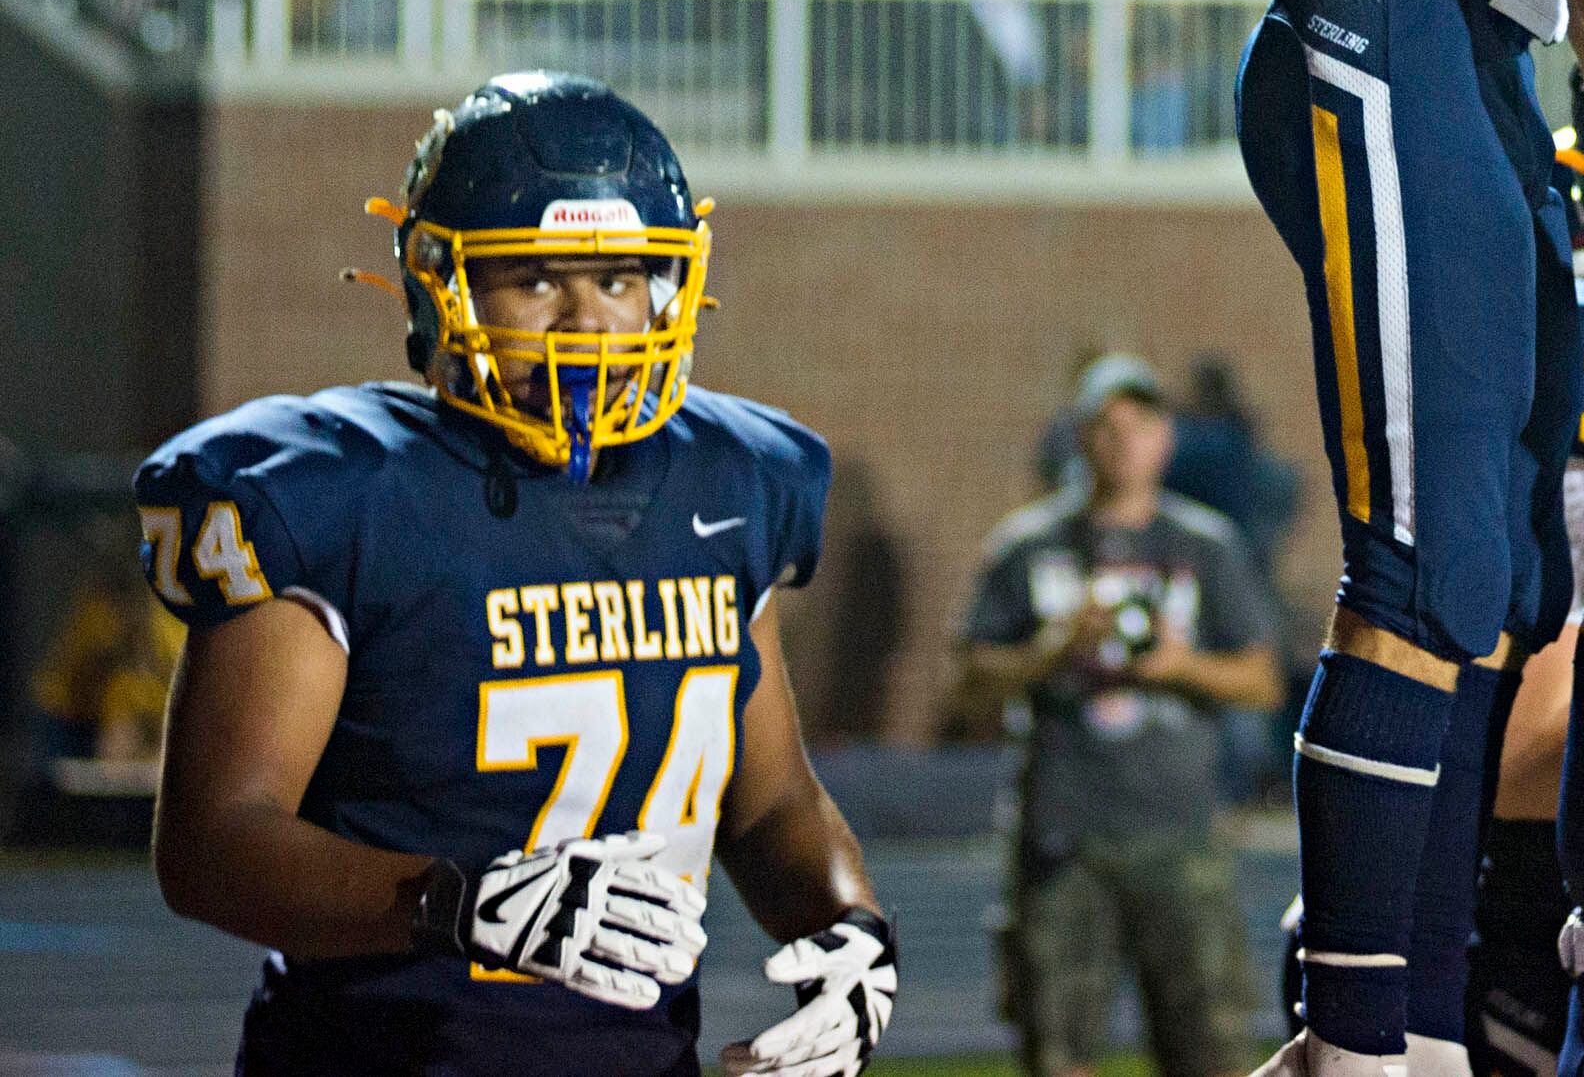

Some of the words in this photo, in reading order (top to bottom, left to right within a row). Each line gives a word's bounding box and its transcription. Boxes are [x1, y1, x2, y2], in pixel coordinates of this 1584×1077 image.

[1308, 14, 1369, 54] STERLING
[137, 500, 274, 605] 74
[486, 575, 741, 669] STERLING
[470, 665, 740, 983] 74
